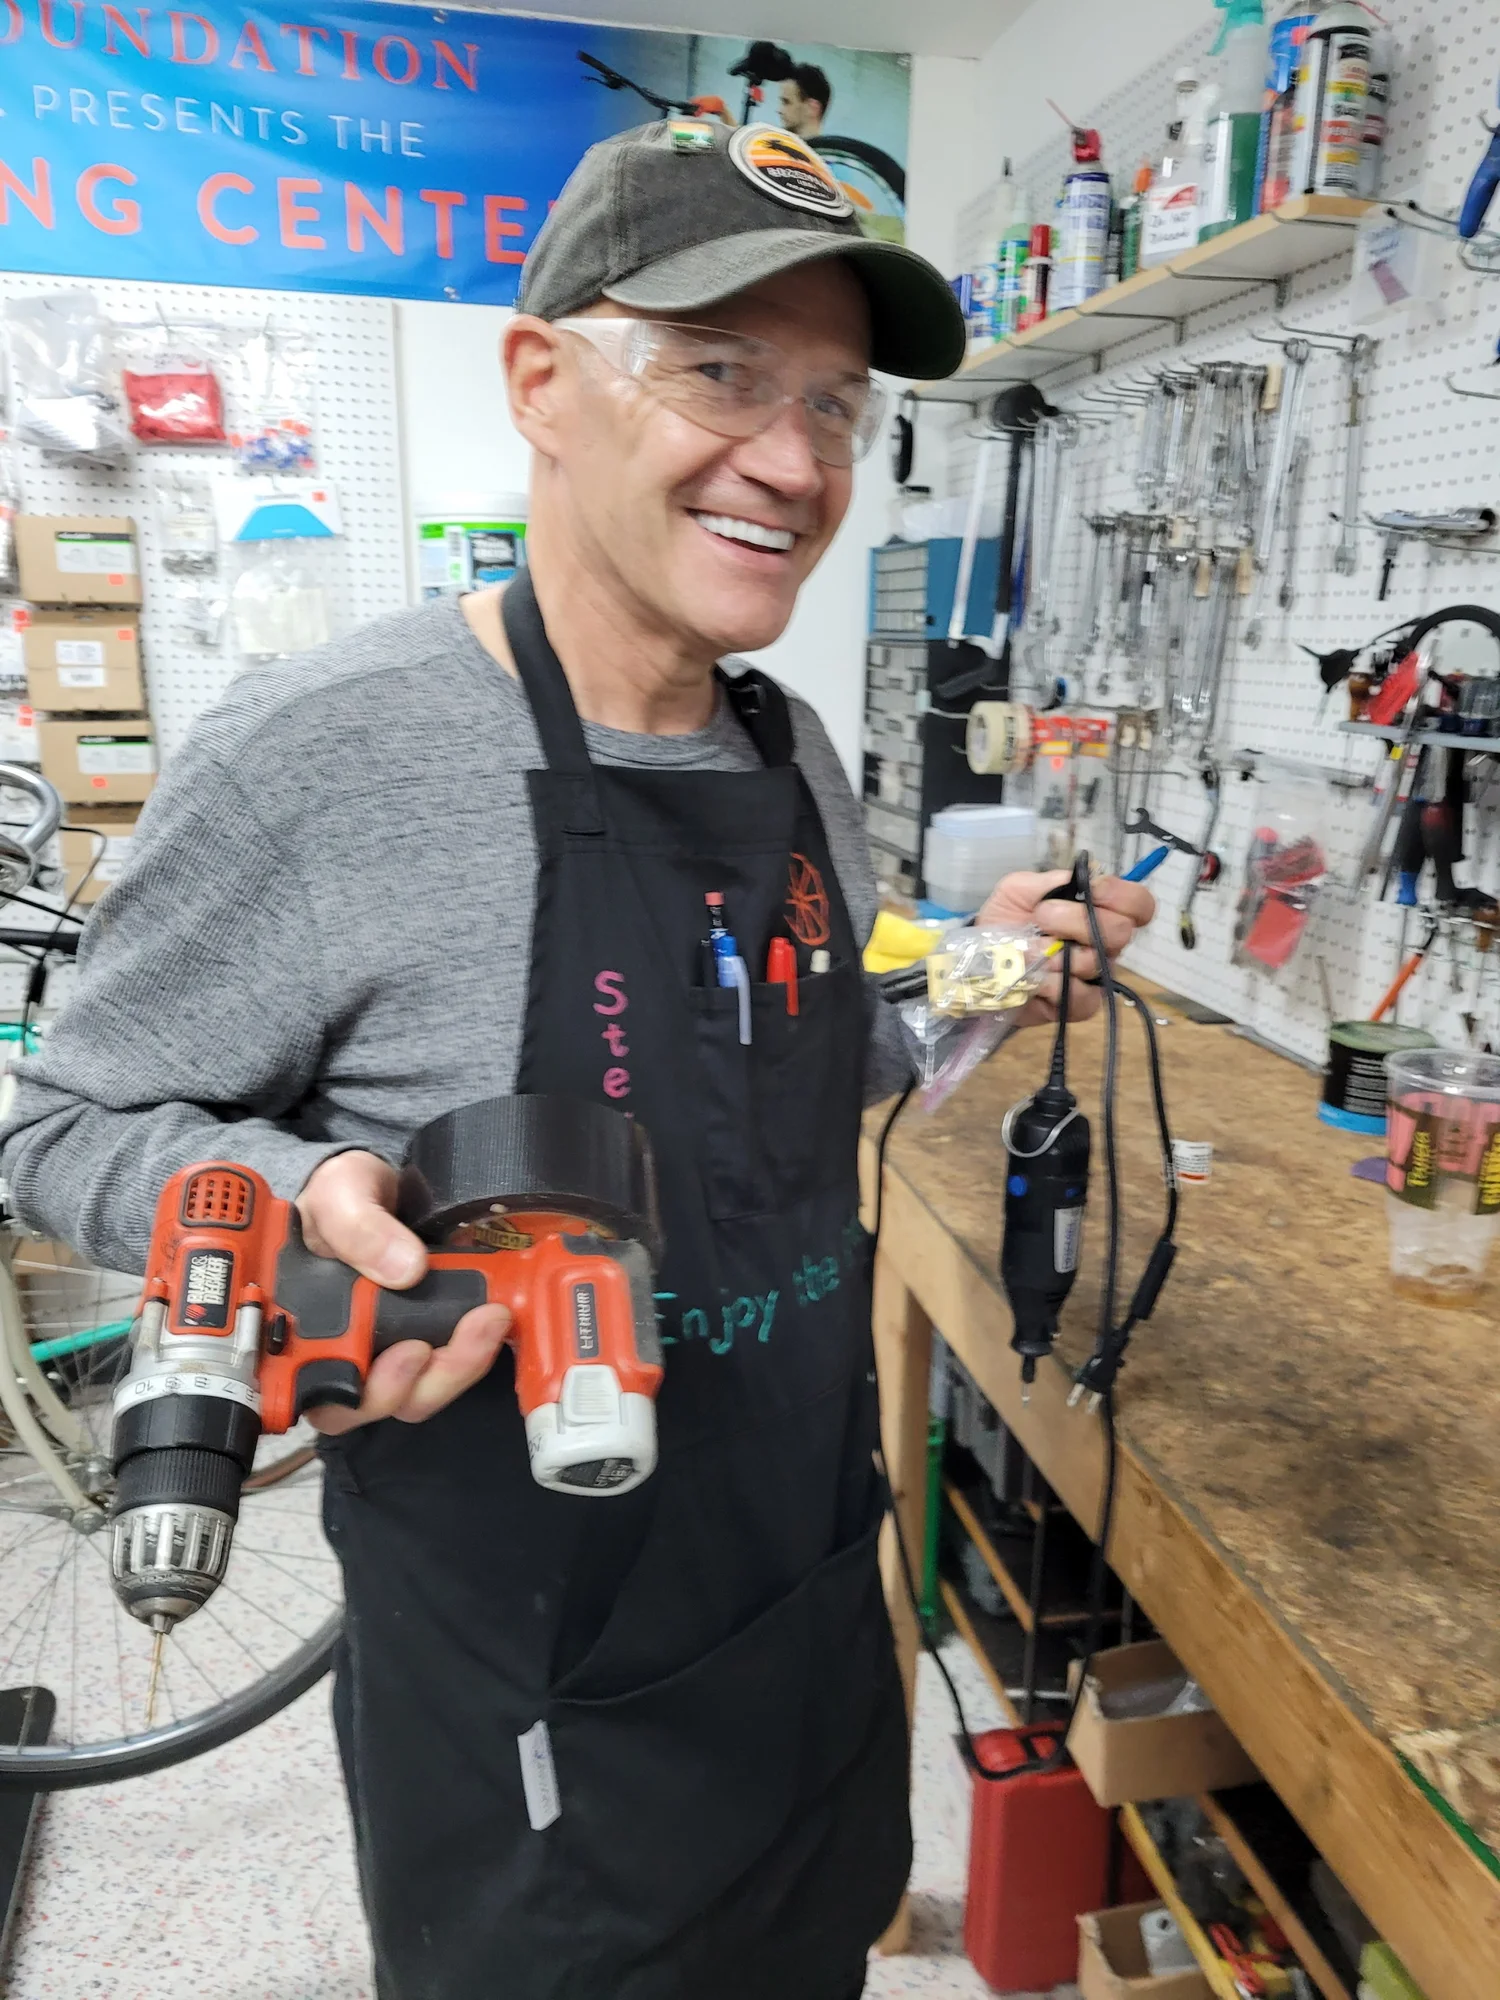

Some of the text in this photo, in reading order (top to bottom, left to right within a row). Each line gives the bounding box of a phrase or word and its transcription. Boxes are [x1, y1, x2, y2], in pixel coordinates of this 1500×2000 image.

[33, 84, 426, 158] PRESENTS THE
[0, 156, 556, 265] NG CENTE
[592, 969, 635, 1119] Ste
[202, 1255, 231, 1305] DECKER
